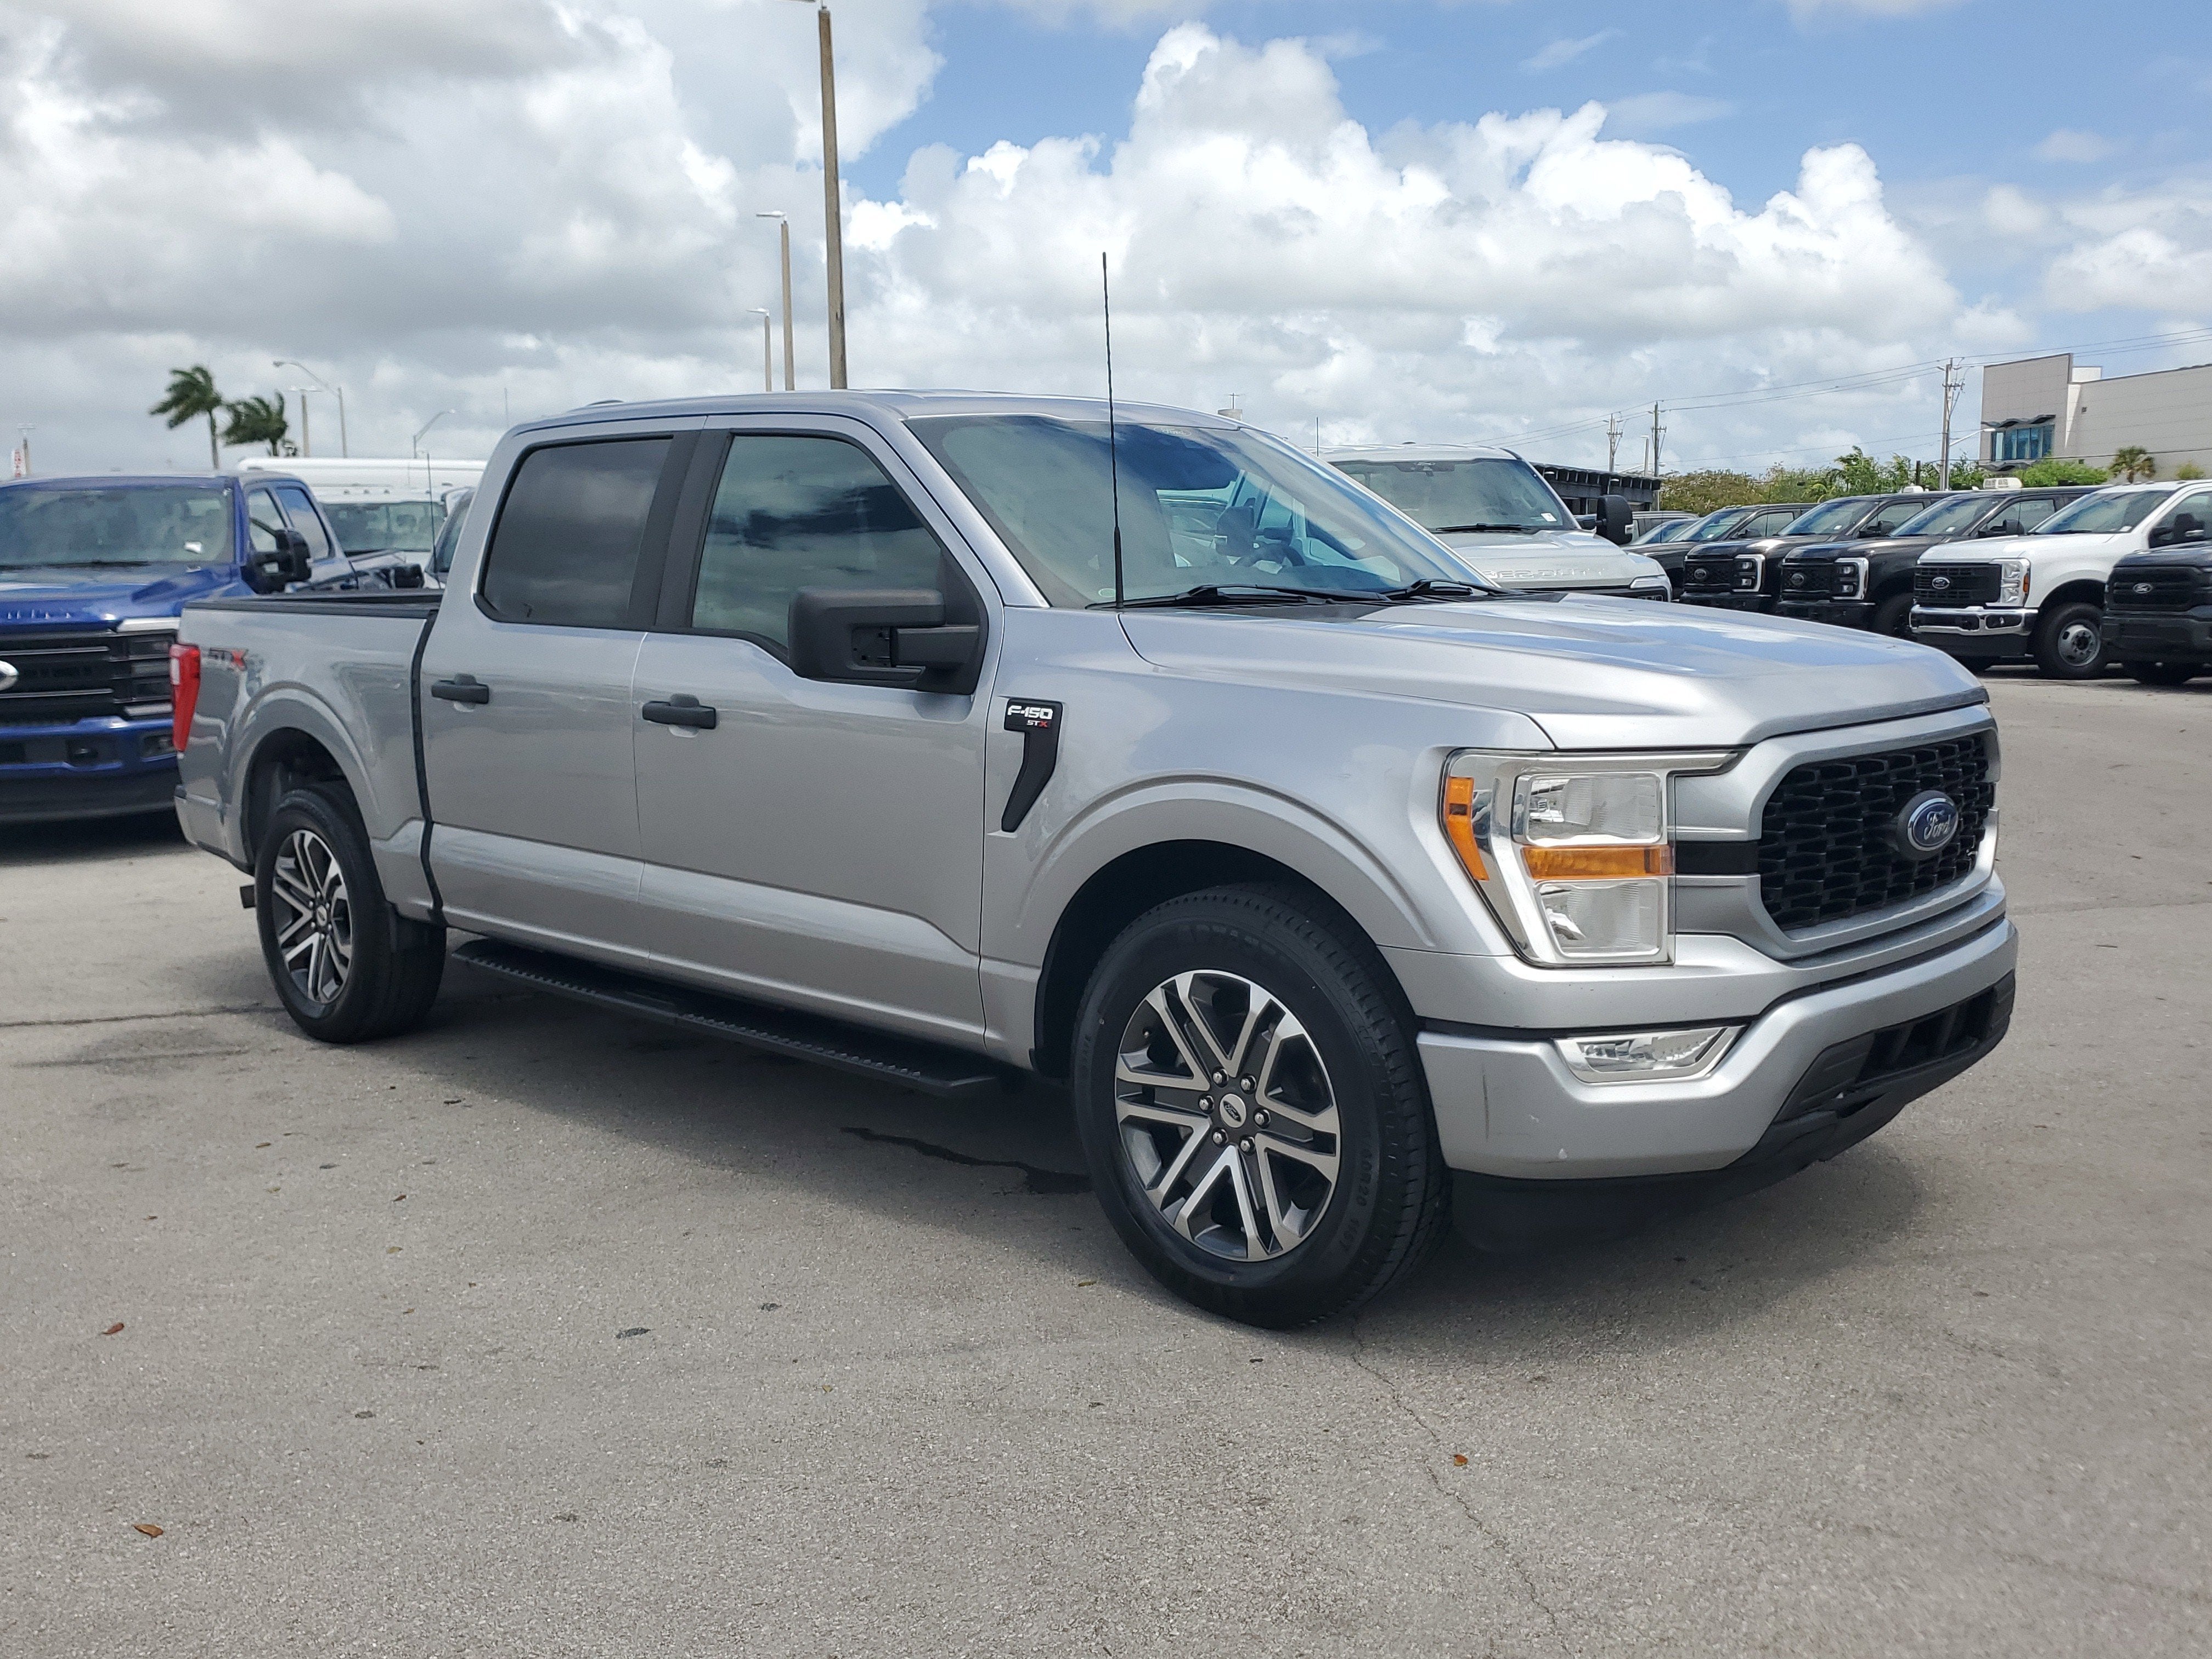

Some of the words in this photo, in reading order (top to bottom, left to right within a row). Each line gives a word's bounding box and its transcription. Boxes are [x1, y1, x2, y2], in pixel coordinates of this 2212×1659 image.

[1007, 705, 1053, 720] F-150
[1026, 720, 1048, 728] STX
[1923, 809, 1951, 840] Ford
[1224, 1104, 1239, 1119] Ford
